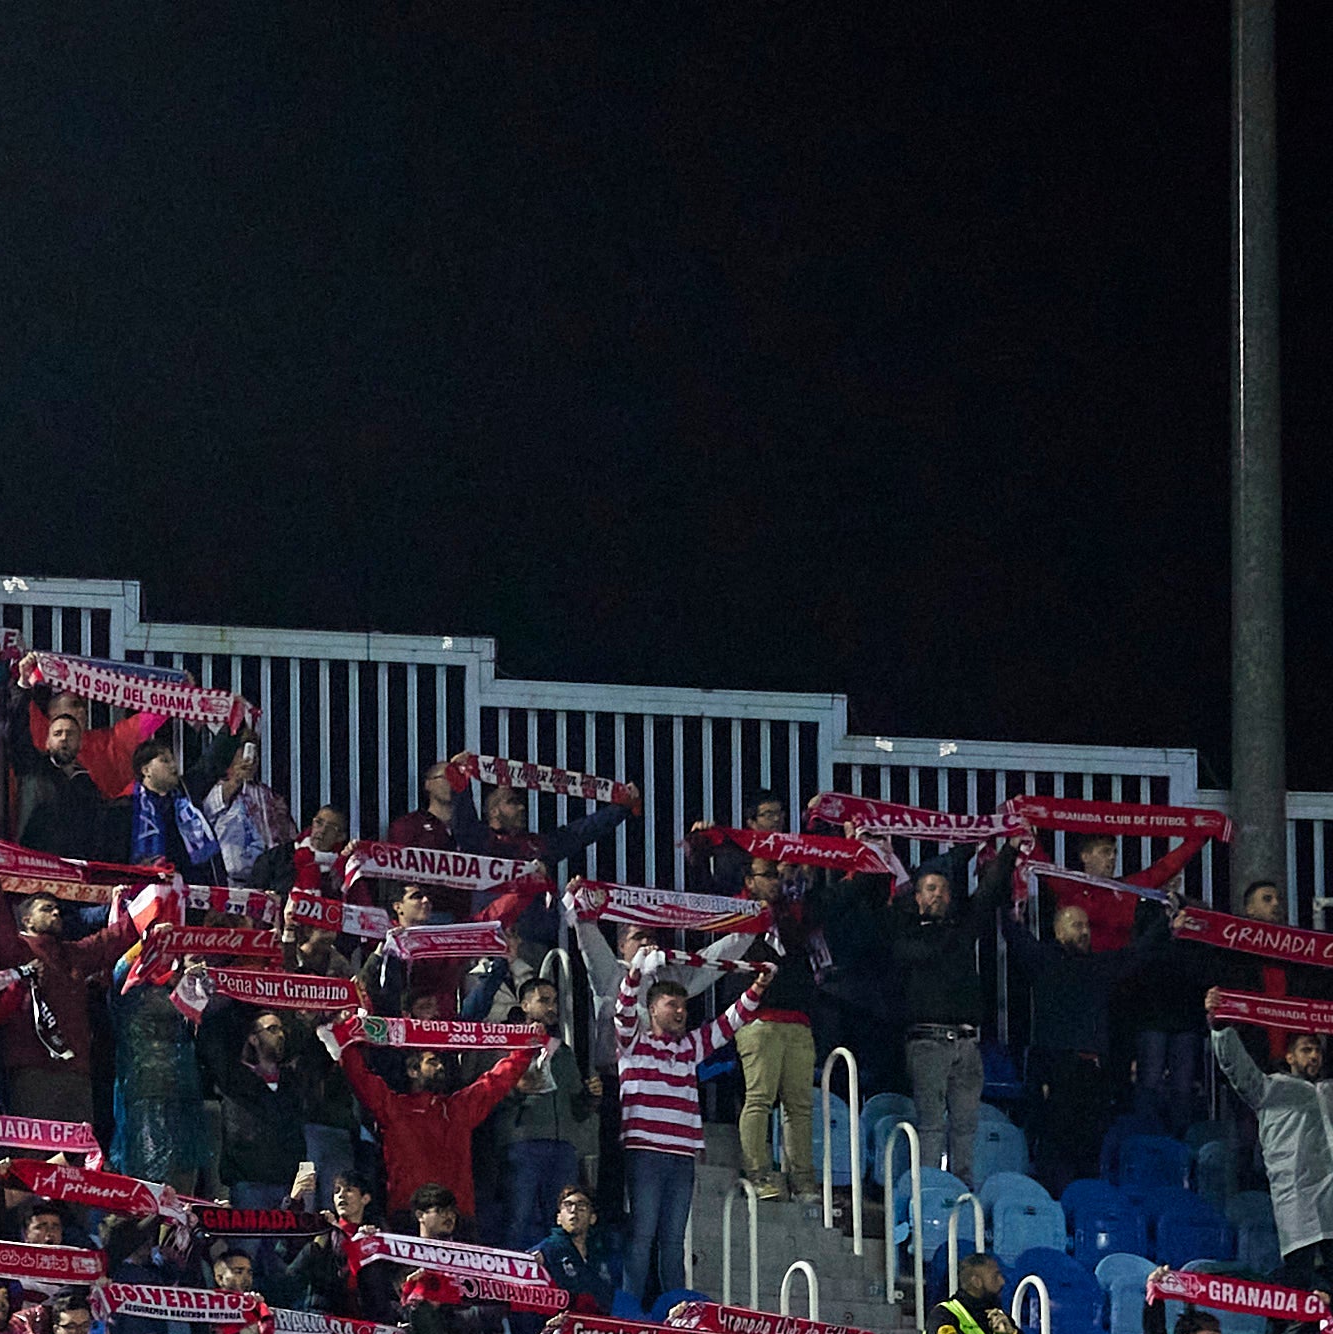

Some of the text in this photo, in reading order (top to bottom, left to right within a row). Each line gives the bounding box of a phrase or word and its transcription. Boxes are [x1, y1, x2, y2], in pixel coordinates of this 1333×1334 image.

[1052, 808, 1148, 826] GRANADA CLUB DE
[373, 845, 483, 881] GRANADA
[1222, 923, 1318, 957] GRANADA
[217, 971, 281, 998] Peña Sur
[203, 1207, 297, 1232] GRANADA
[1208, 1278, 1293, 1312] GRANADA
